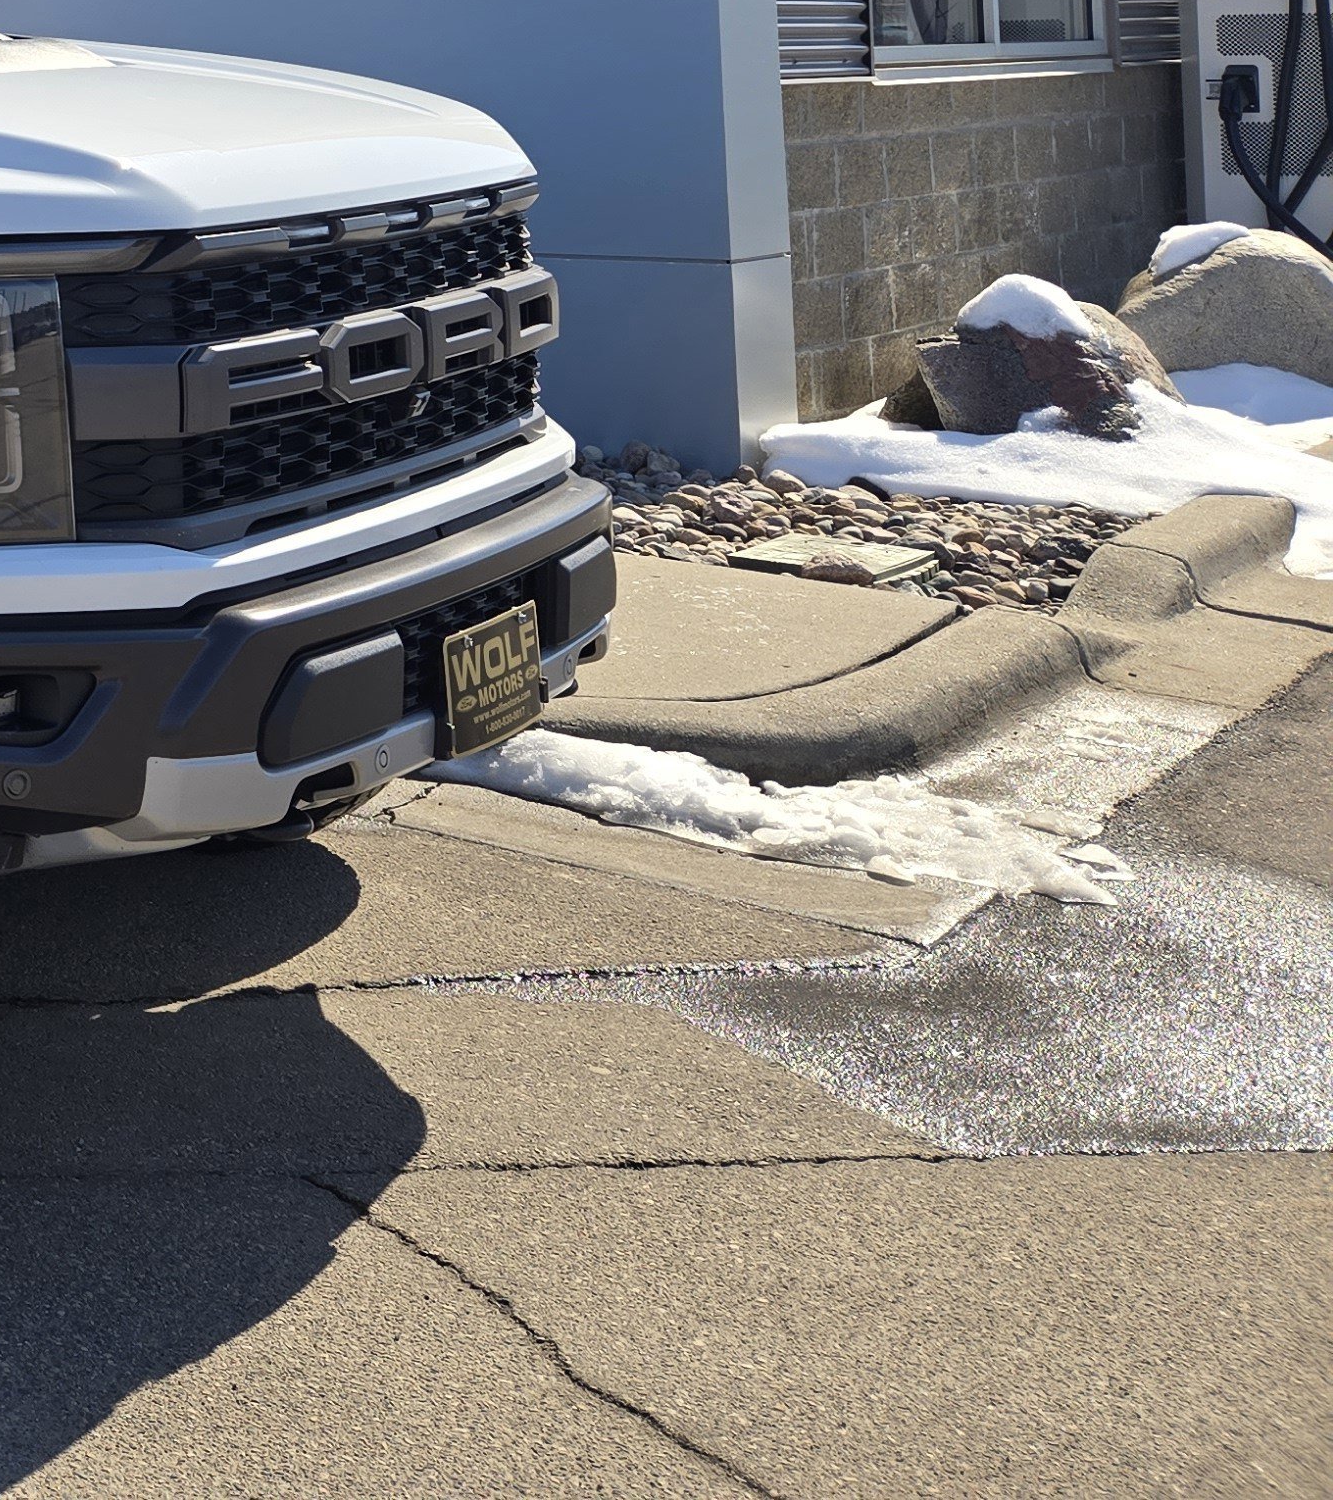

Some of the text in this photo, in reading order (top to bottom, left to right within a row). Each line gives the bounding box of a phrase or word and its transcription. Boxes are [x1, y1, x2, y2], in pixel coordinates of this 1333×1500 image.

[182, 265, 560, 434] FORD
[451, 621, 536, 692] WOLF
[477, 669, 524, 708] MOTORS
